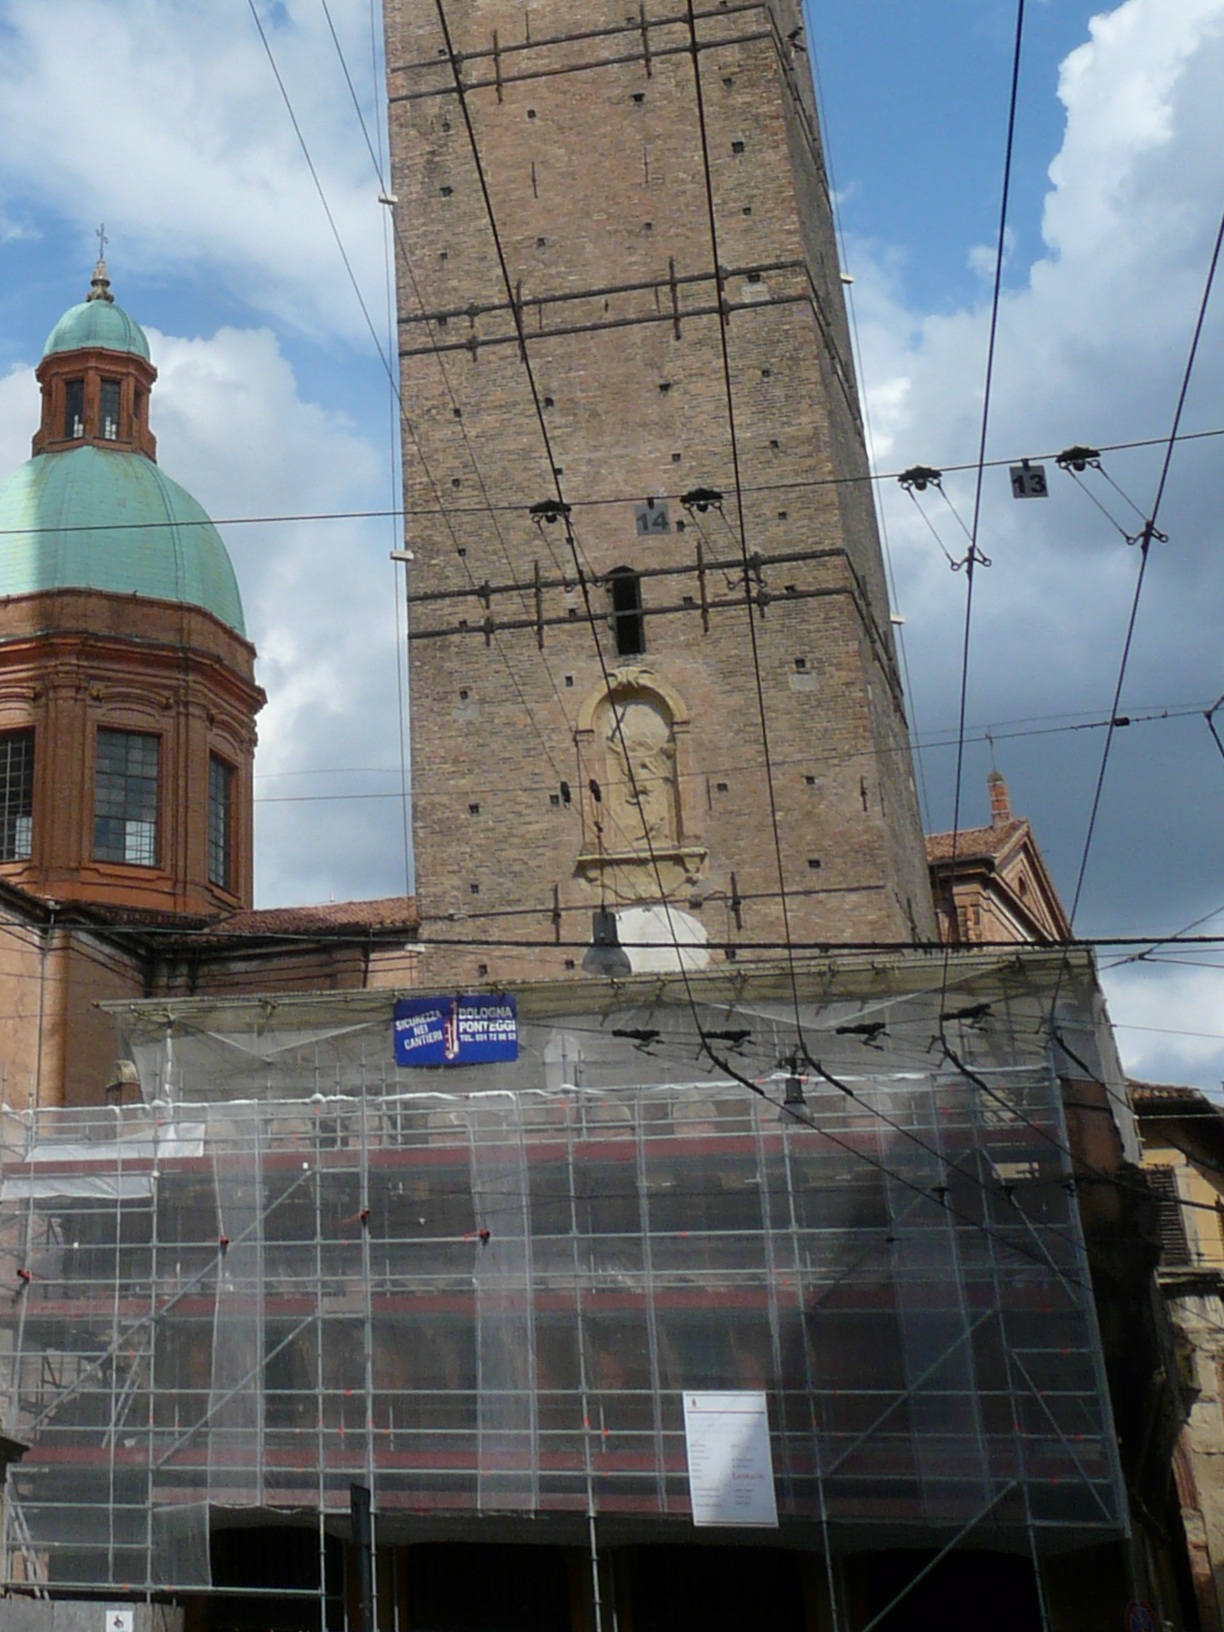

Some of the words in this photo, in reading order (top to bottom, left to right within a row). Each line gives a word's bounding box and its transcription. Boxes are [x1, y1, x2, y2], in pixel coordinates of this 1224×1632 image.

[1013, 474, 1046, 493] 13
[636, 511, 669, 531] 14
[395, 1010, 442, 1031] SICUREZZA
[458, 1006, 513, 1019] BOLOGNA
[413, 1024, 429, 1036] NEI
[459, 1020, 516, 1033] PONTEGGI
[404, 1030, 443, 1050] CANTIERI
